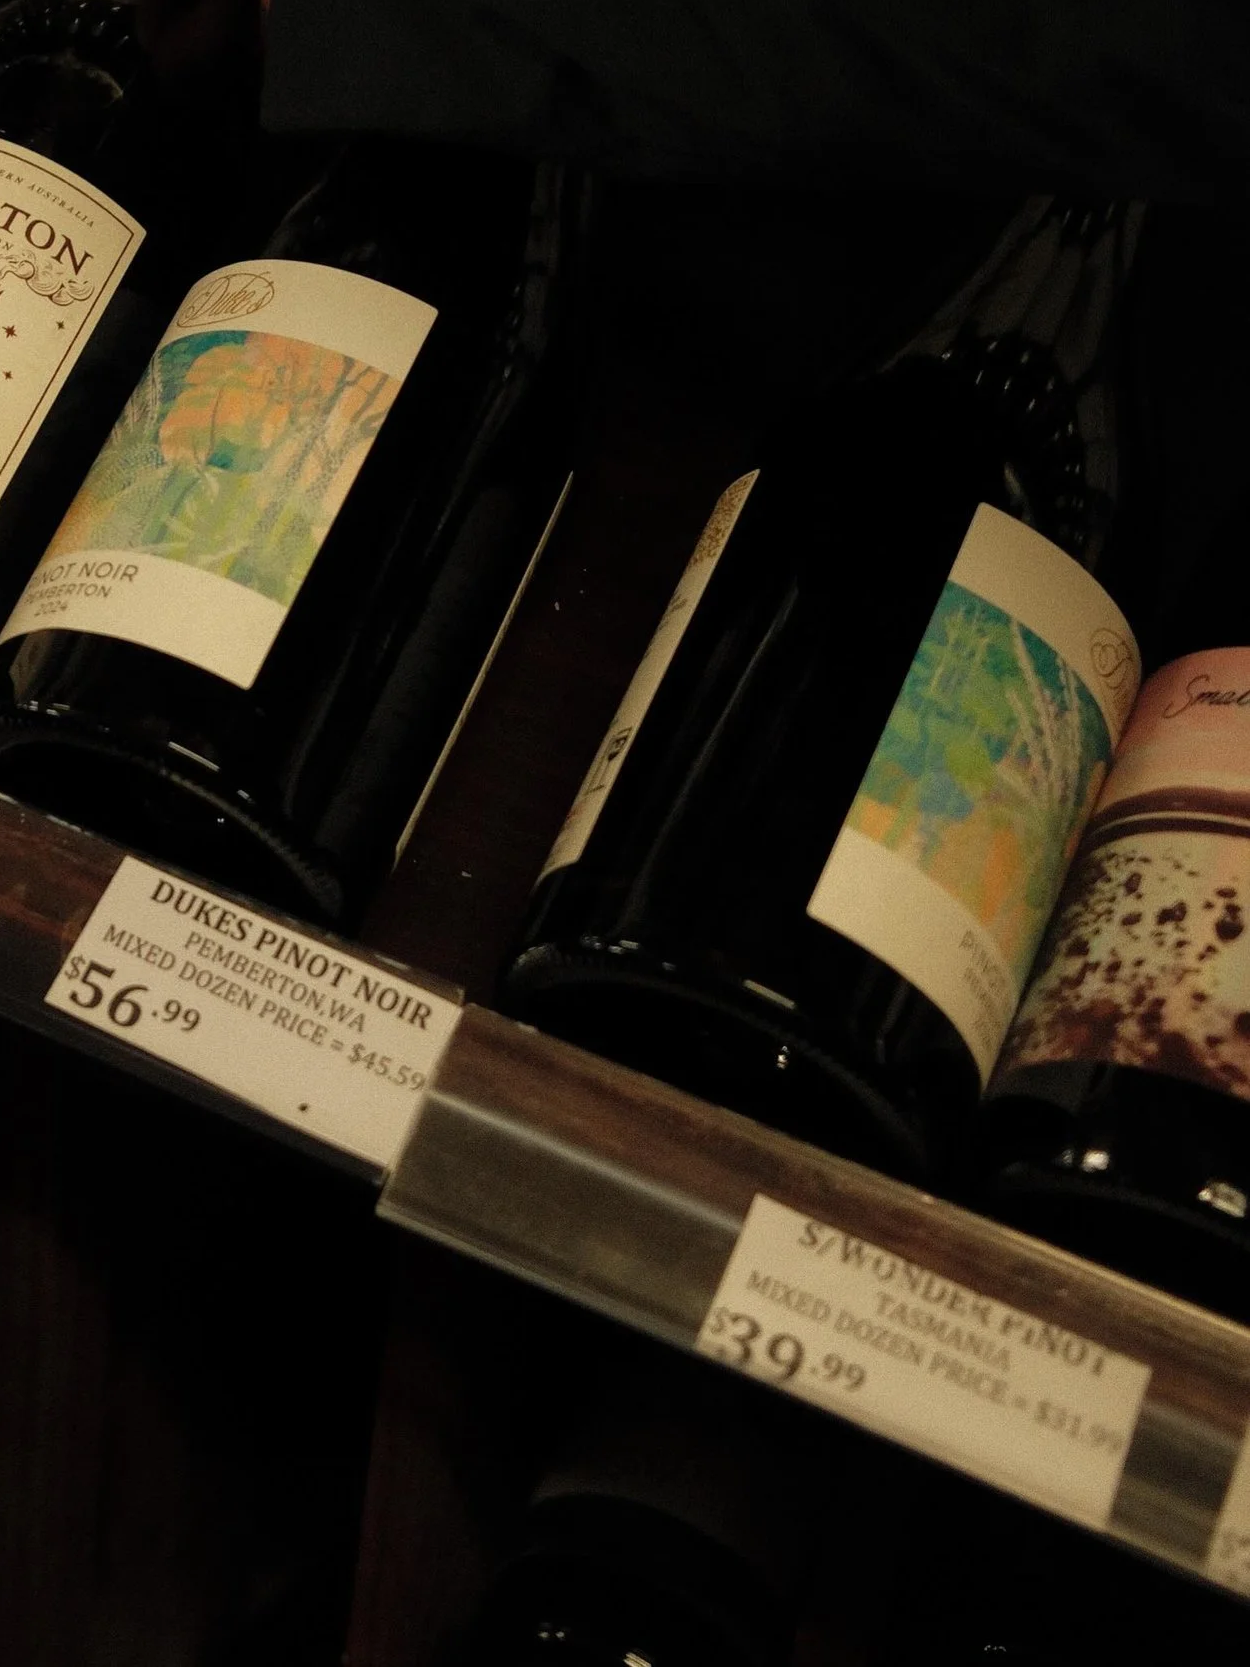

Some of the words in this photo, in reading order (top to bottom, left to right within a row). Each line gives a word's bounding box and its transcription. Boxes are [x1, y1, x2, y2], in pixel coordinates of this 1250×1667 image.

[27, 183, 95, 229] AUSTRALIA
[77, 561, 140, 583] NOIR
[150, 877, 254, 943] DUKES
[253, 927, 353, 990] PINOT
[350, 974, 434, 1031] NOIR
[183, 929, 368, 1034] PEMBERTON,WA
[102, 923, 177, 972] MIXED
[177, 958, 256, 1011] DOZEN
[257, 998, 326, 1047] PRICE
[346, 1041, 427, 1092] $45.59
[749, 1269, 832, 1324] MIXED
[833, 1309, 925, 1368] DOZEN
[928, 1350, 1010, 1406] PRICE
[875, 1290, 1012, 1374] TASMANIA
